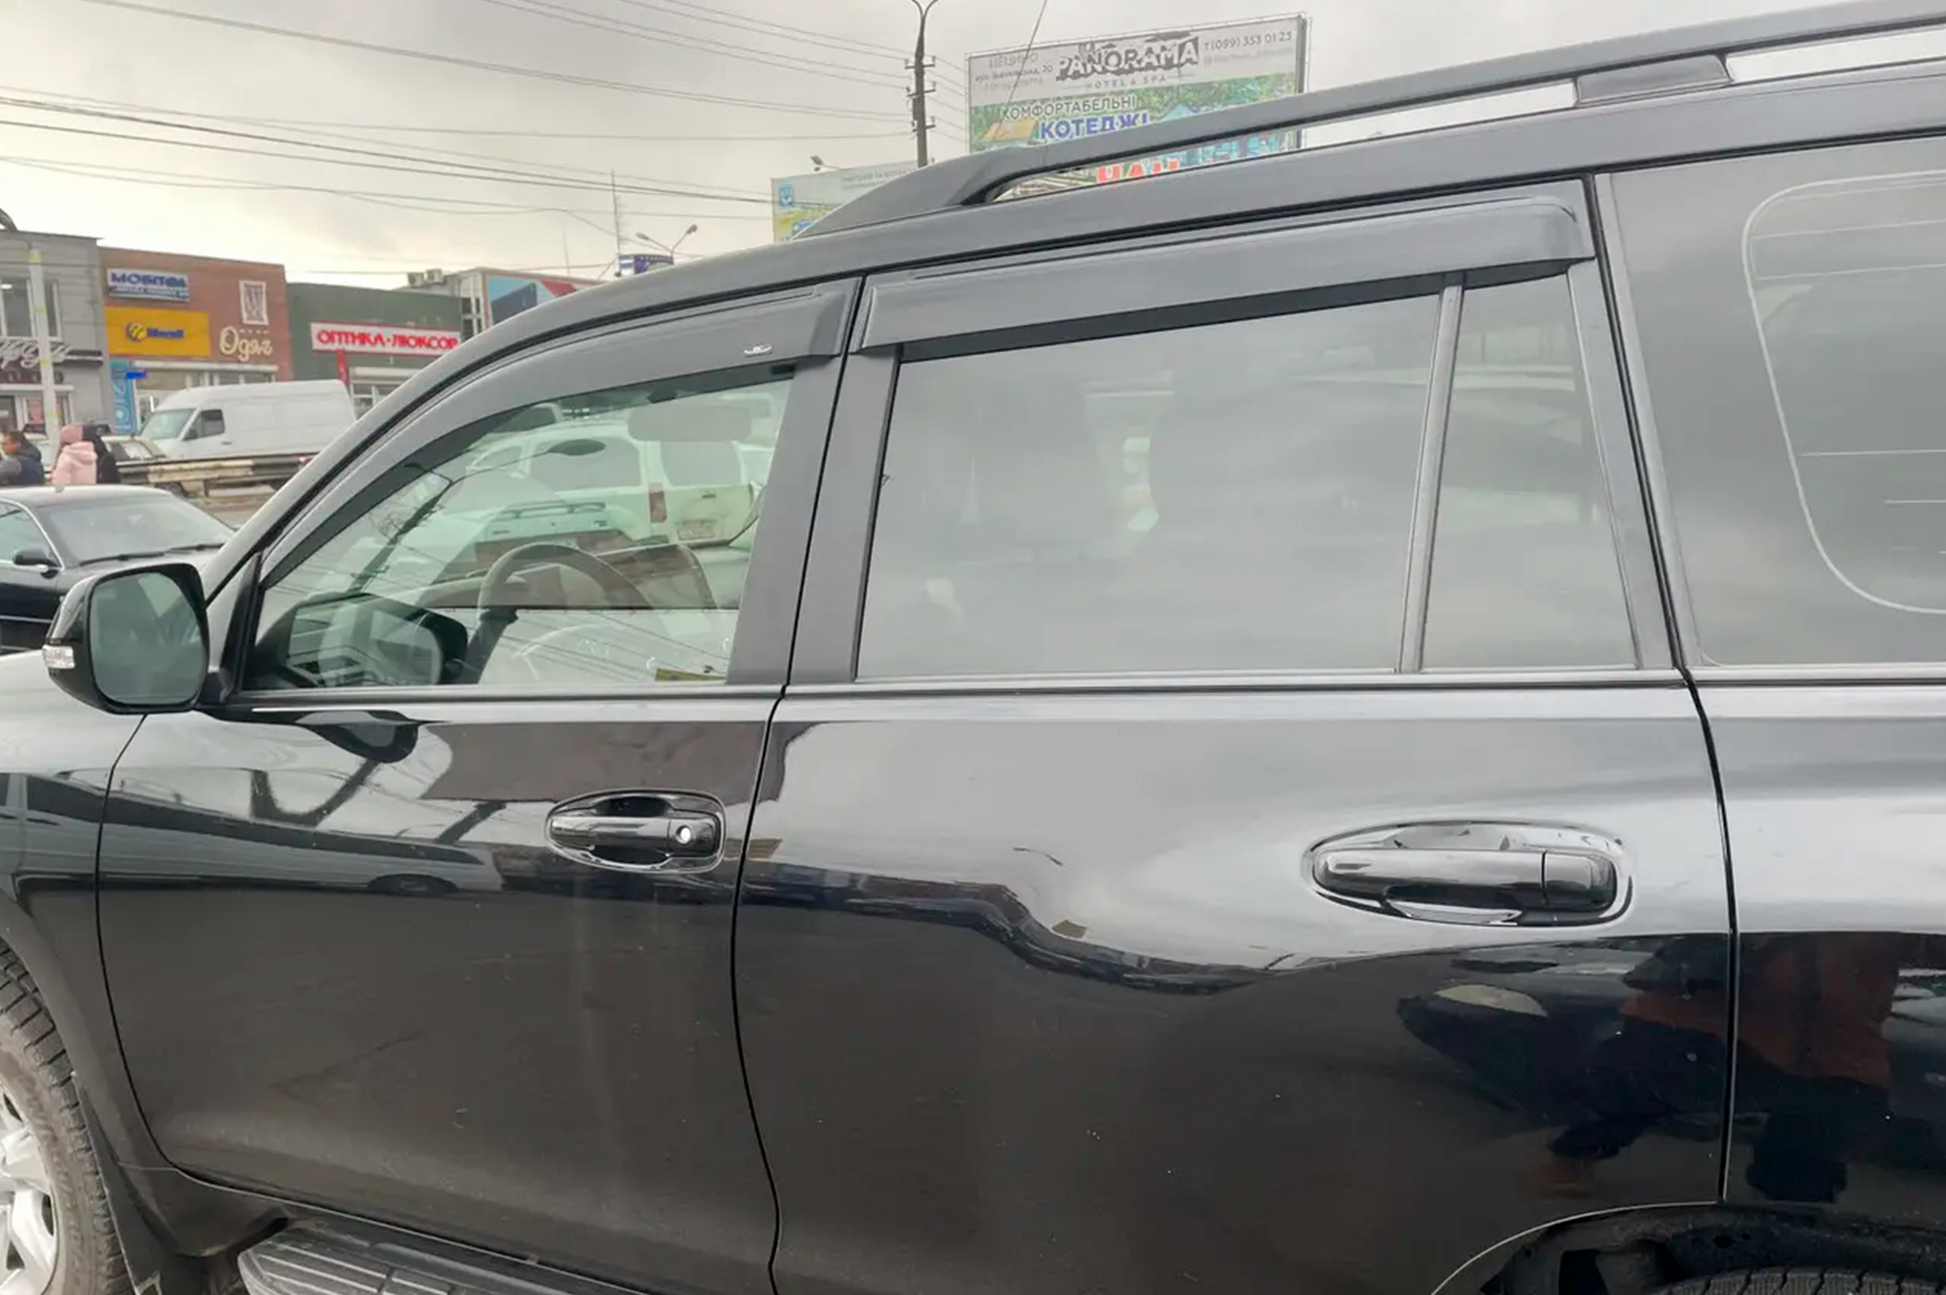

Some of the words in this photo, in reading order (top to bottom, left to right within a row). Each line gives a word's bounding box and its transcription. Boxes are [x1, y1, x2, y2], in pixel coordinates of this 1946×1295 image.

[1056, 37, 1199, 80] PANORAMA
[1086, 79, 1125, 91] HOTEL
[1142, 73, 1167, 85] SPA
[1000, 95, 1137, 121] КОМФОРТАБЕЛЬНІ
[1040, 113, 1149, 140] КОТЕДЖІ
